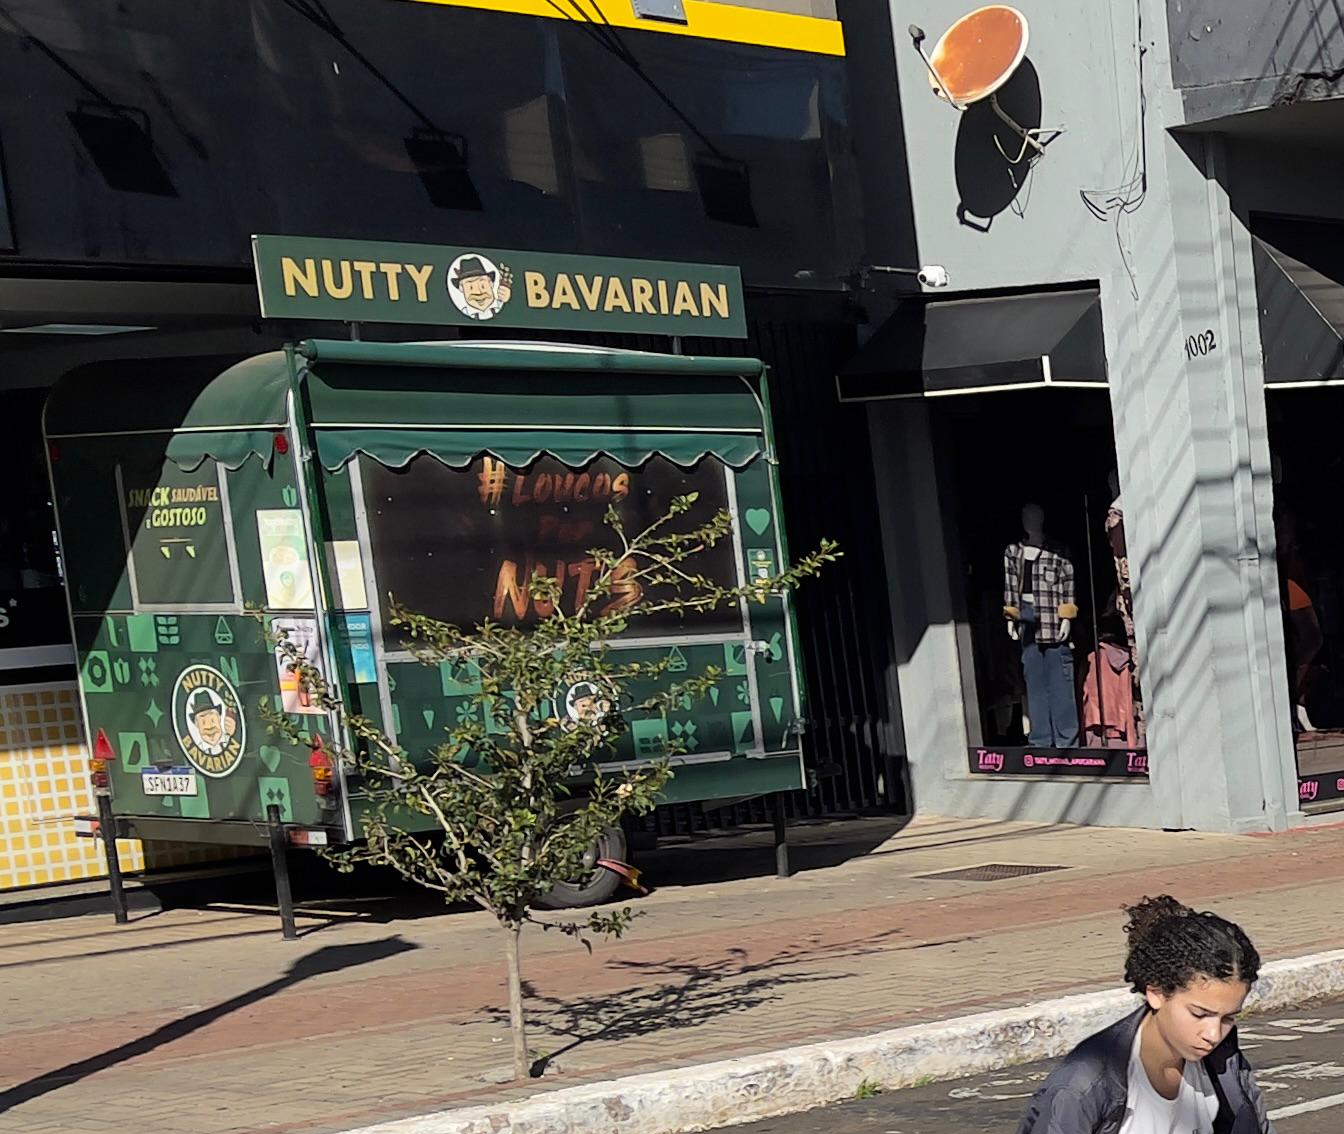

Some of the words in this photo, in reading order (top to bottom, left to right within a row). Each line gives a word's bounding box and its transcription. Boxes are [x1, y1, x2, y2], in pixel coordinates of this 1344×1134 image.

[281, 257, 433, 302] NUTTY
[525, 271, 730, 319] BAVARIAN
[1184, 329, 1217, 361] 1002
[129, 486, 170, 507] SNACK
[171, 484, 218, 502] SAUDÁVEL
[152, 507, 207, 527] GOSTOSO
[182, 671, 222, 692] NUTTY
[181, 736, 241, 771] BAVARIAN
[977, 750, 1004, 771] Taty
